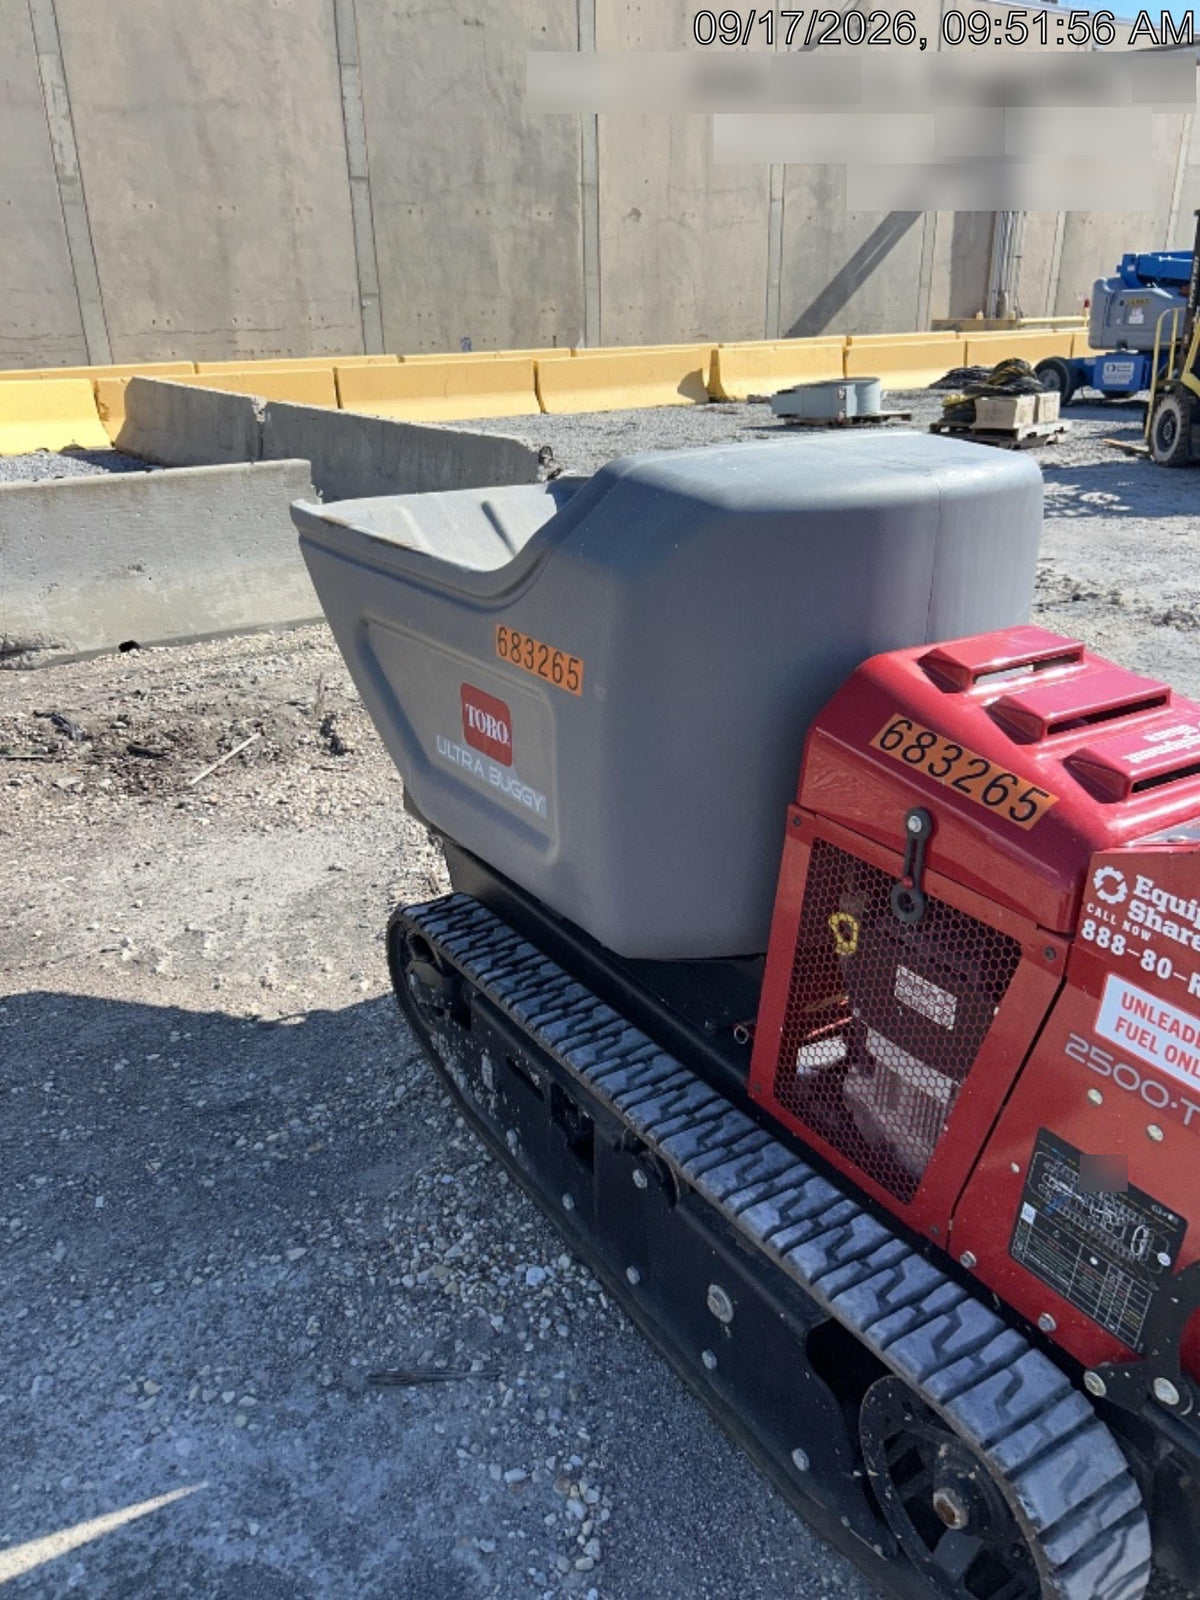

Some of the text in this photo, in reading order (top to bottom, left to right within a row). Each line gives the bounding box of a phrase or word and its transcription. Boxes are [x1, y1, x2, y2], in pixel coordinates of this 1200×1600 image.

[497, 626, 580, 692] 683265
[464, 703, 509, 745] TORO
[435, 734, 547, 814] ULTRA BUGGY
[878, 718, 1050, 823] 683265
[1086, 902, 1152, 942] CALL NOW
[1115, 1015, 1158, 1056] FUEL
